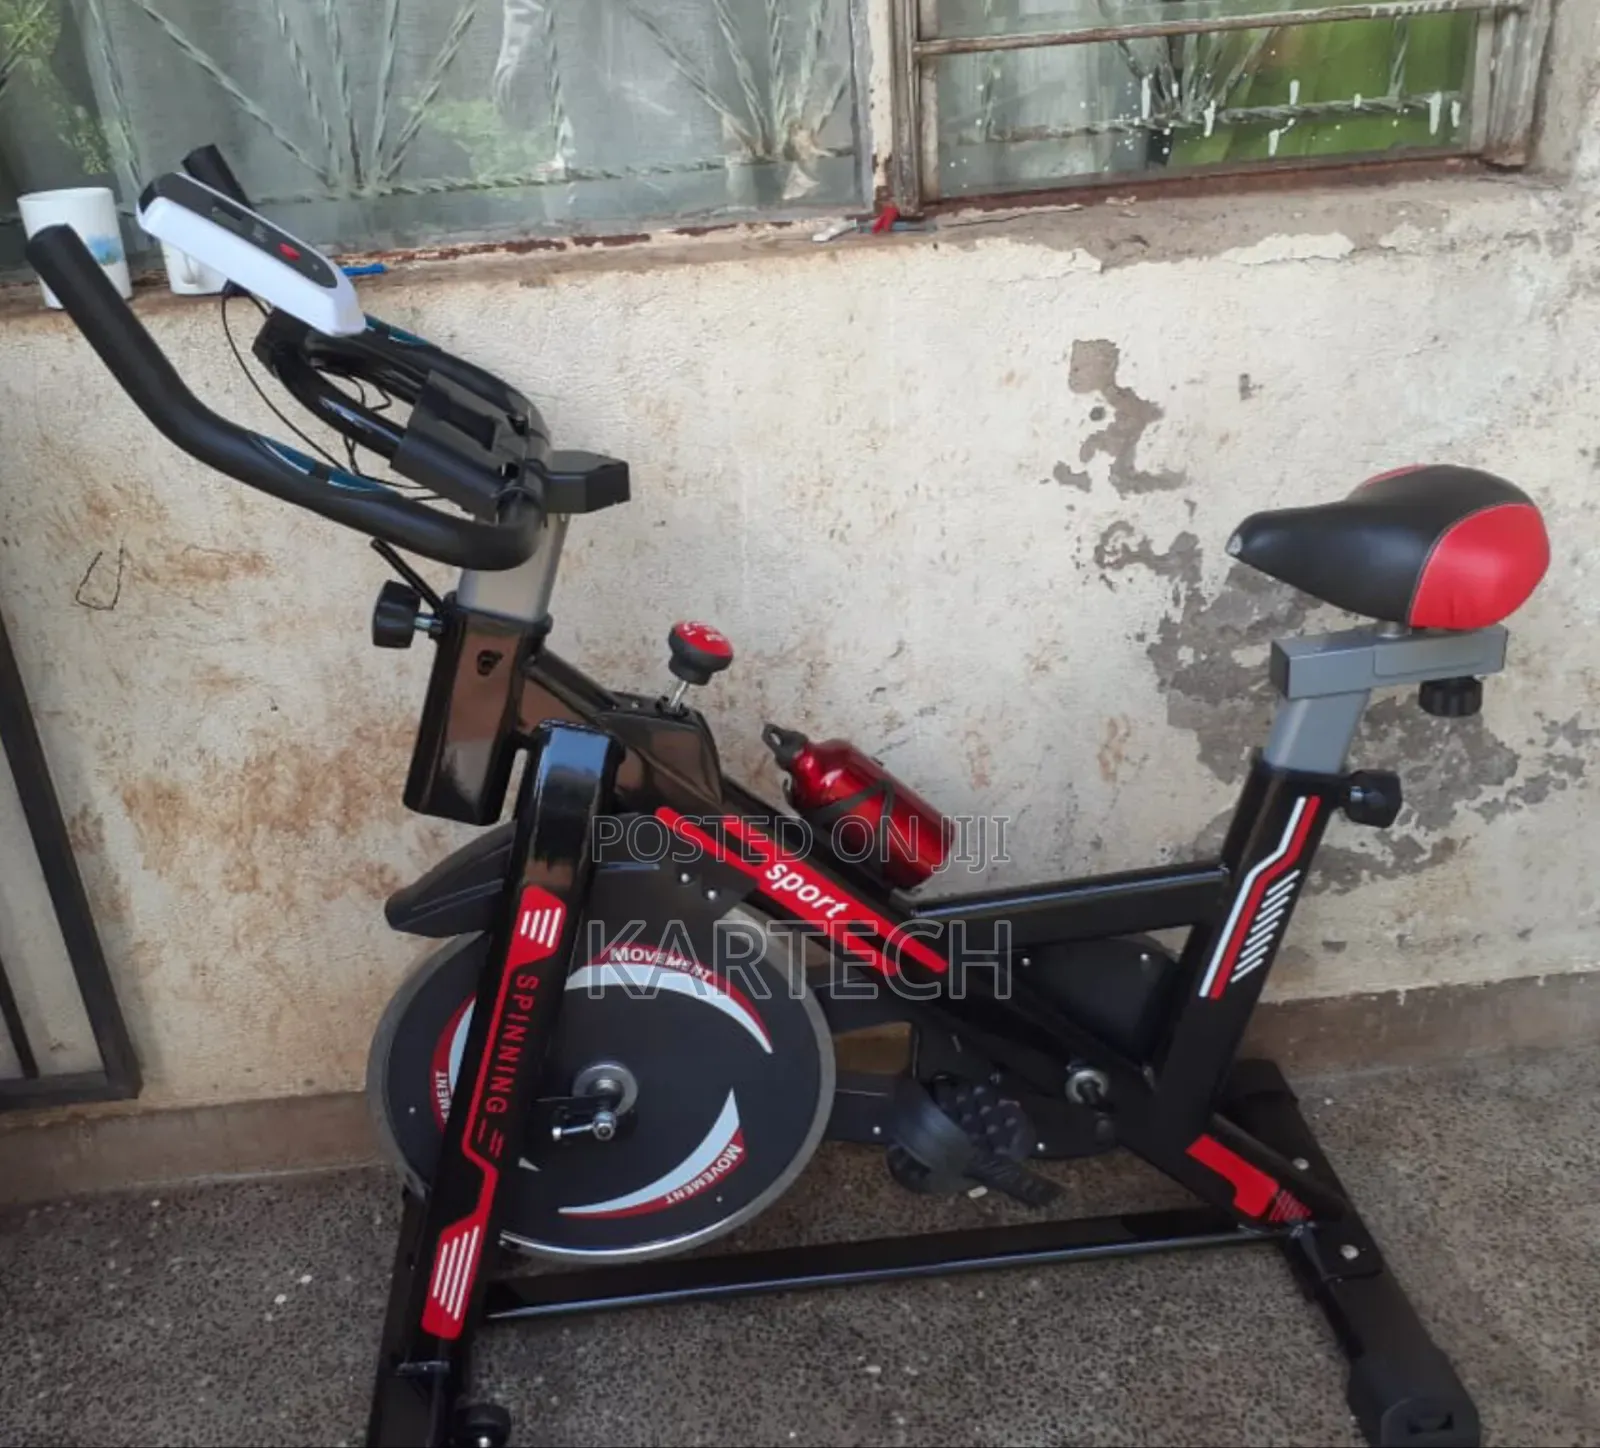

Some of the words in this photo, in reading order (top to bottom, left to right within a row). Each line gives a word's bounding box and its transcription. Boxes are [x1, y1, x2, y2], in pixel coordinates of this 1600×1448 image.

[764, 861, 849, 920] sport
[609, 945, 714, 981] MOVEMENT
[485, 974, 540, 1114] SPINNING
[665, 1143, 744, 1204] MOVEMENT
